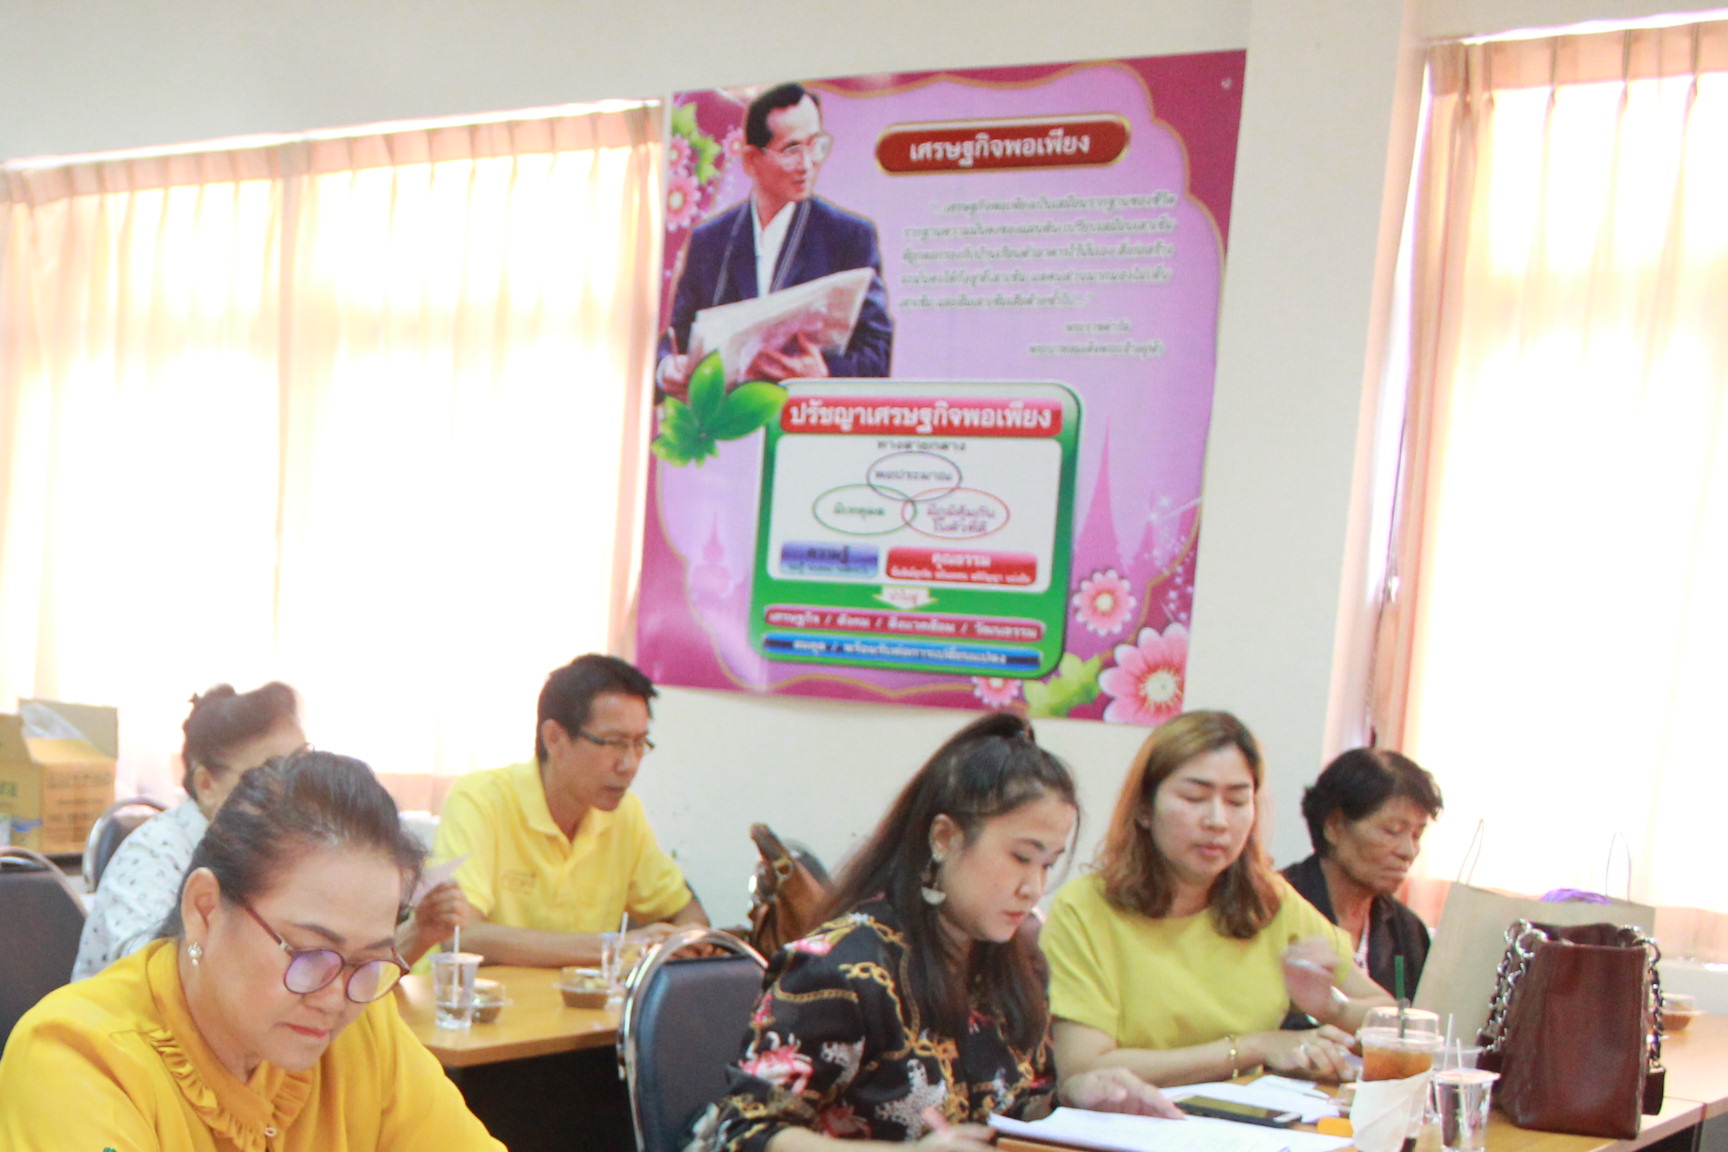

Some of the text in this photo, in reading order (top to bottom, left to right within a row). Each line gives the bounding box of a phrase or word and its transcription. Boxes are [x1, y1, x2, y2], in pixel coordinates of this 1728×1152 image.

[909, 129, 1090, 167] เศรษฐกิจพอเพียง
[790, 400, 1052, 432] ปรัชญาเศรษฐกิจพอเพียง
